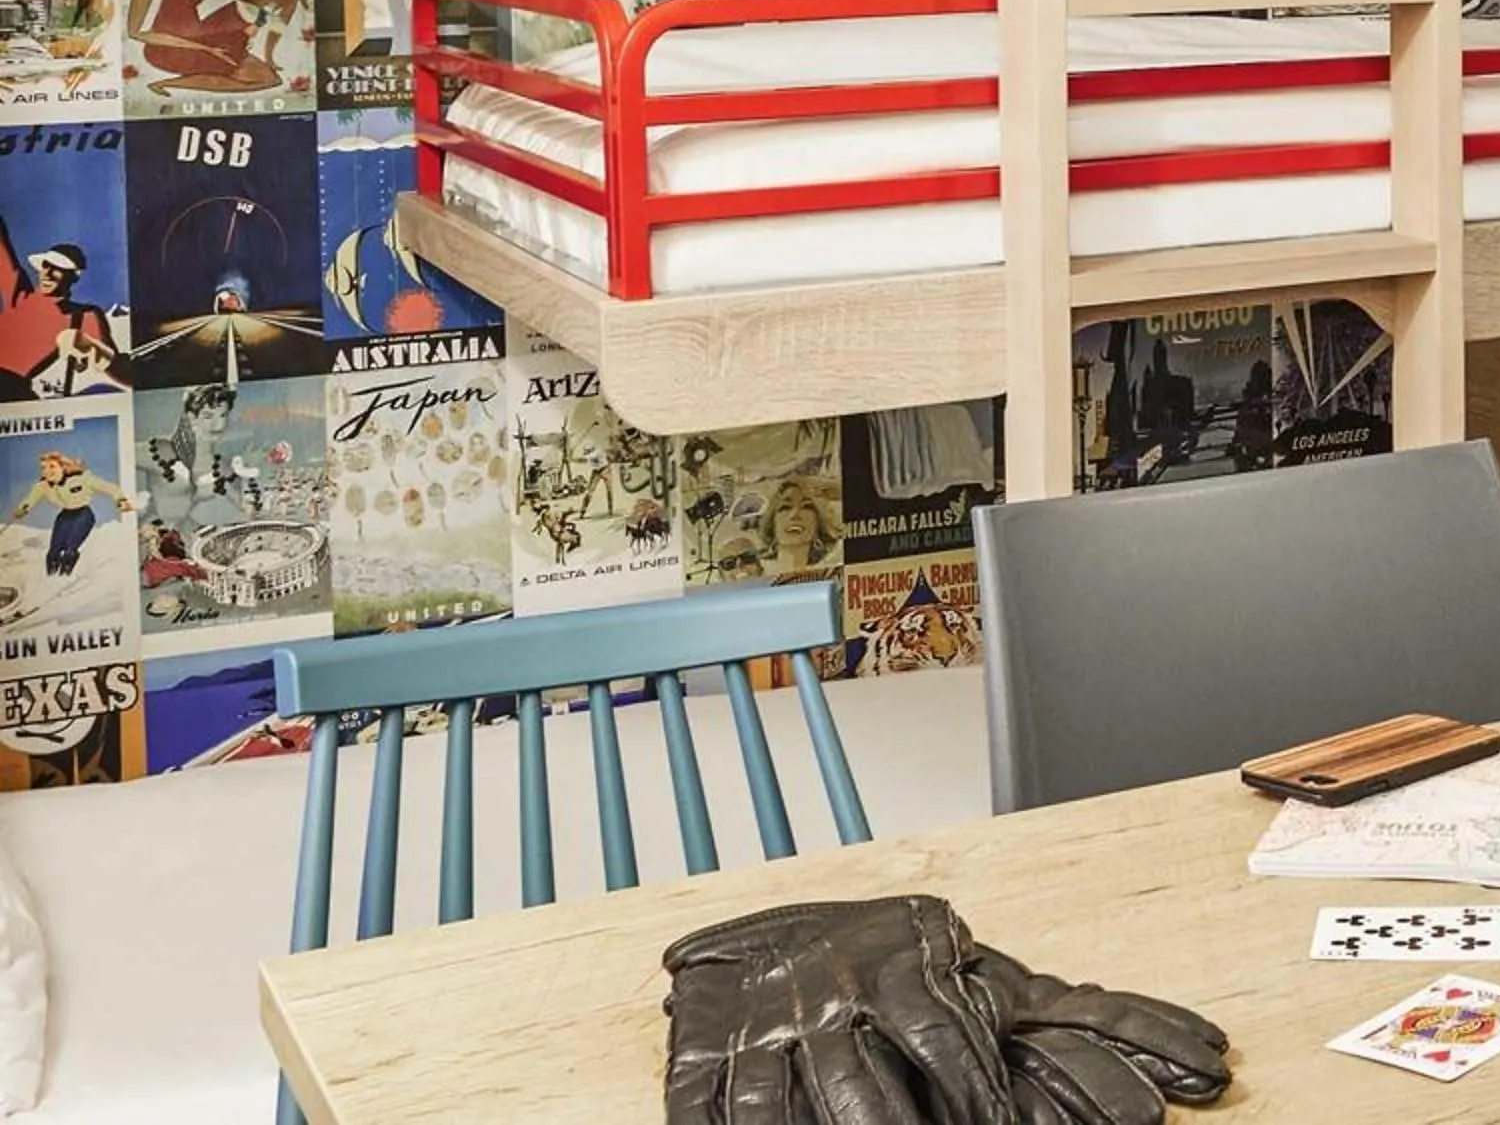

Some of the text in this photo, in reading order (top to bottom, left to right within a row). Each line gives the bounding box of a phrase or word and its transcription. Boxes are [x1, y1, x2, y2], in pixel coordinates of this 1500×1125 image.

[12, 90, 118, 103] AIR LINES
[182, 99, 285, 115] UNITED
[0, 123, 124, 156] stria
[177, 126, 253, 168] DSB
[332, 336, 499, 373] AUSTRALIA
[333, 375, 497, 442] Japan
[0, 415, 65, 435] WINTER
[1292, 428, 1370, 451] LOS ANGELES
[910, 509, 953, 531] FALLS
[536, 556, 679, 584] DELTA AIR LINES
[848, 569, 914, 610] RINGLING
[950, 585, 980, 607] BAIL
[387, 601, 483, 623] UNITED
[0, 627, 123, 659] UN VALLEY
[0, 661, 139, 729] EXAS
